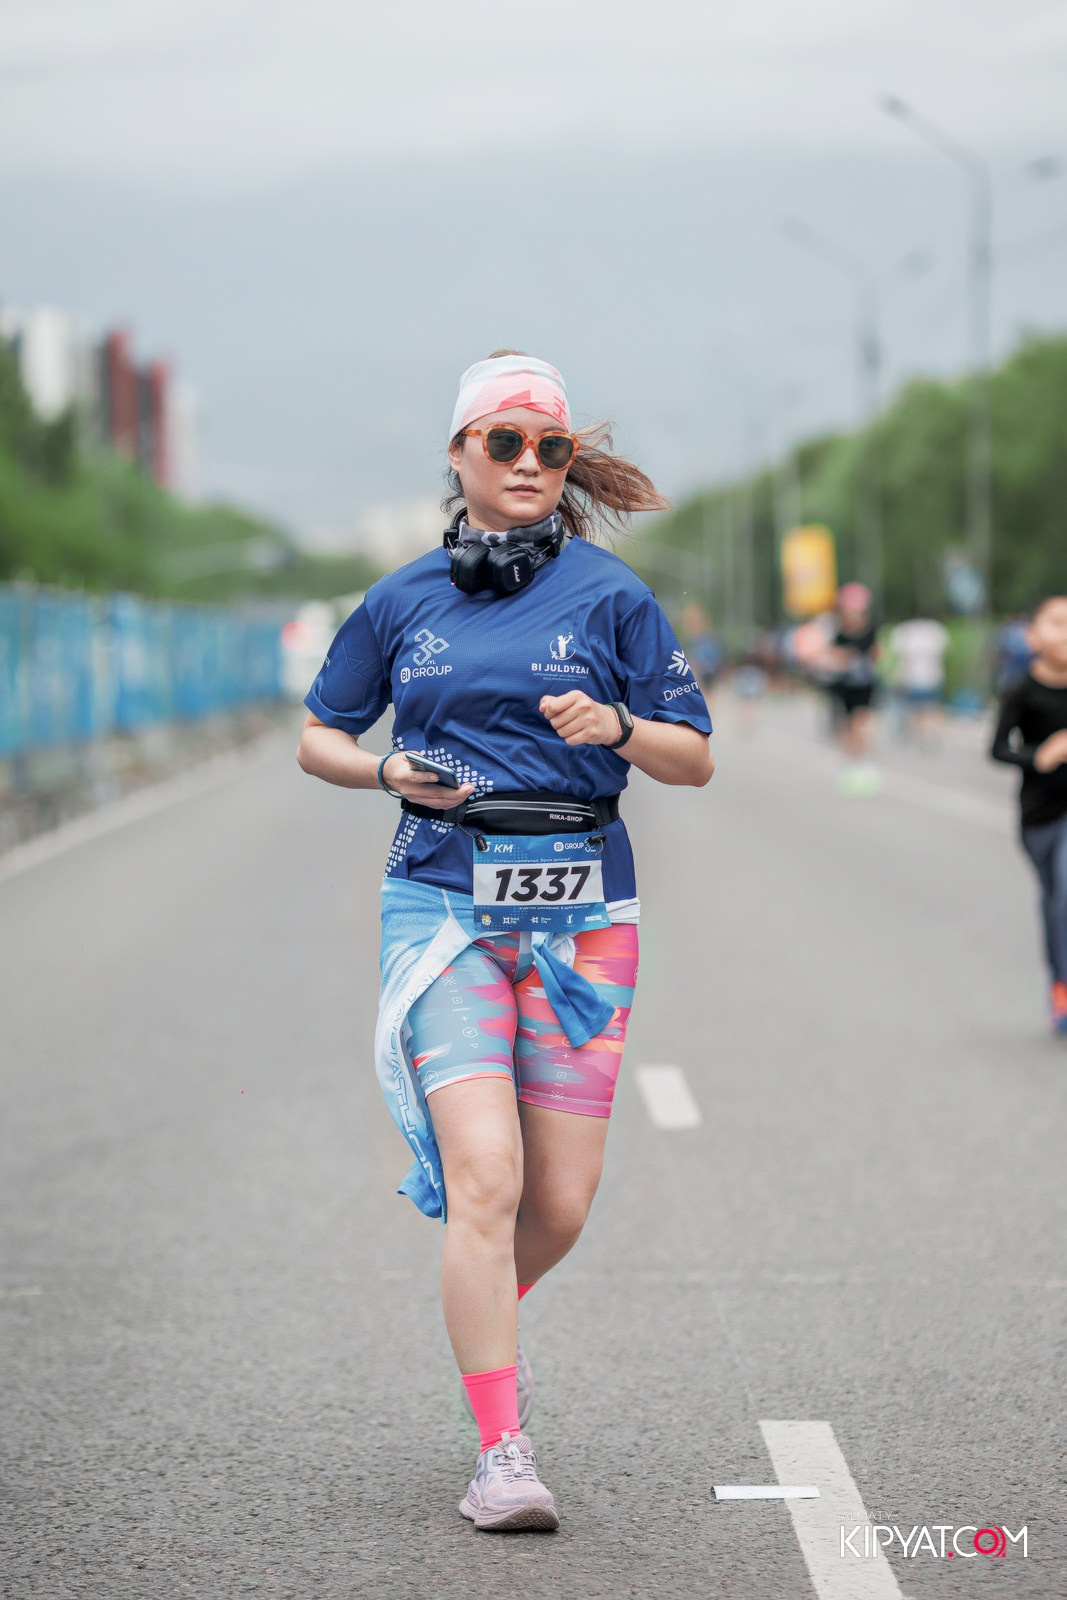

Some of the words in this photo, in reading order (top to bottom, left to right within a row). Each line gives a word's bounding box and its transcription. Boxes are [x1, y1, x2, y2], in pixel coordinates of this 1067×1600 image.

[412, 666, 453, 678] GROUP
[531, 663, 542, 671] BI
[494, 844, 514, 853] KM
[495, 865, 591, 902] 1337
